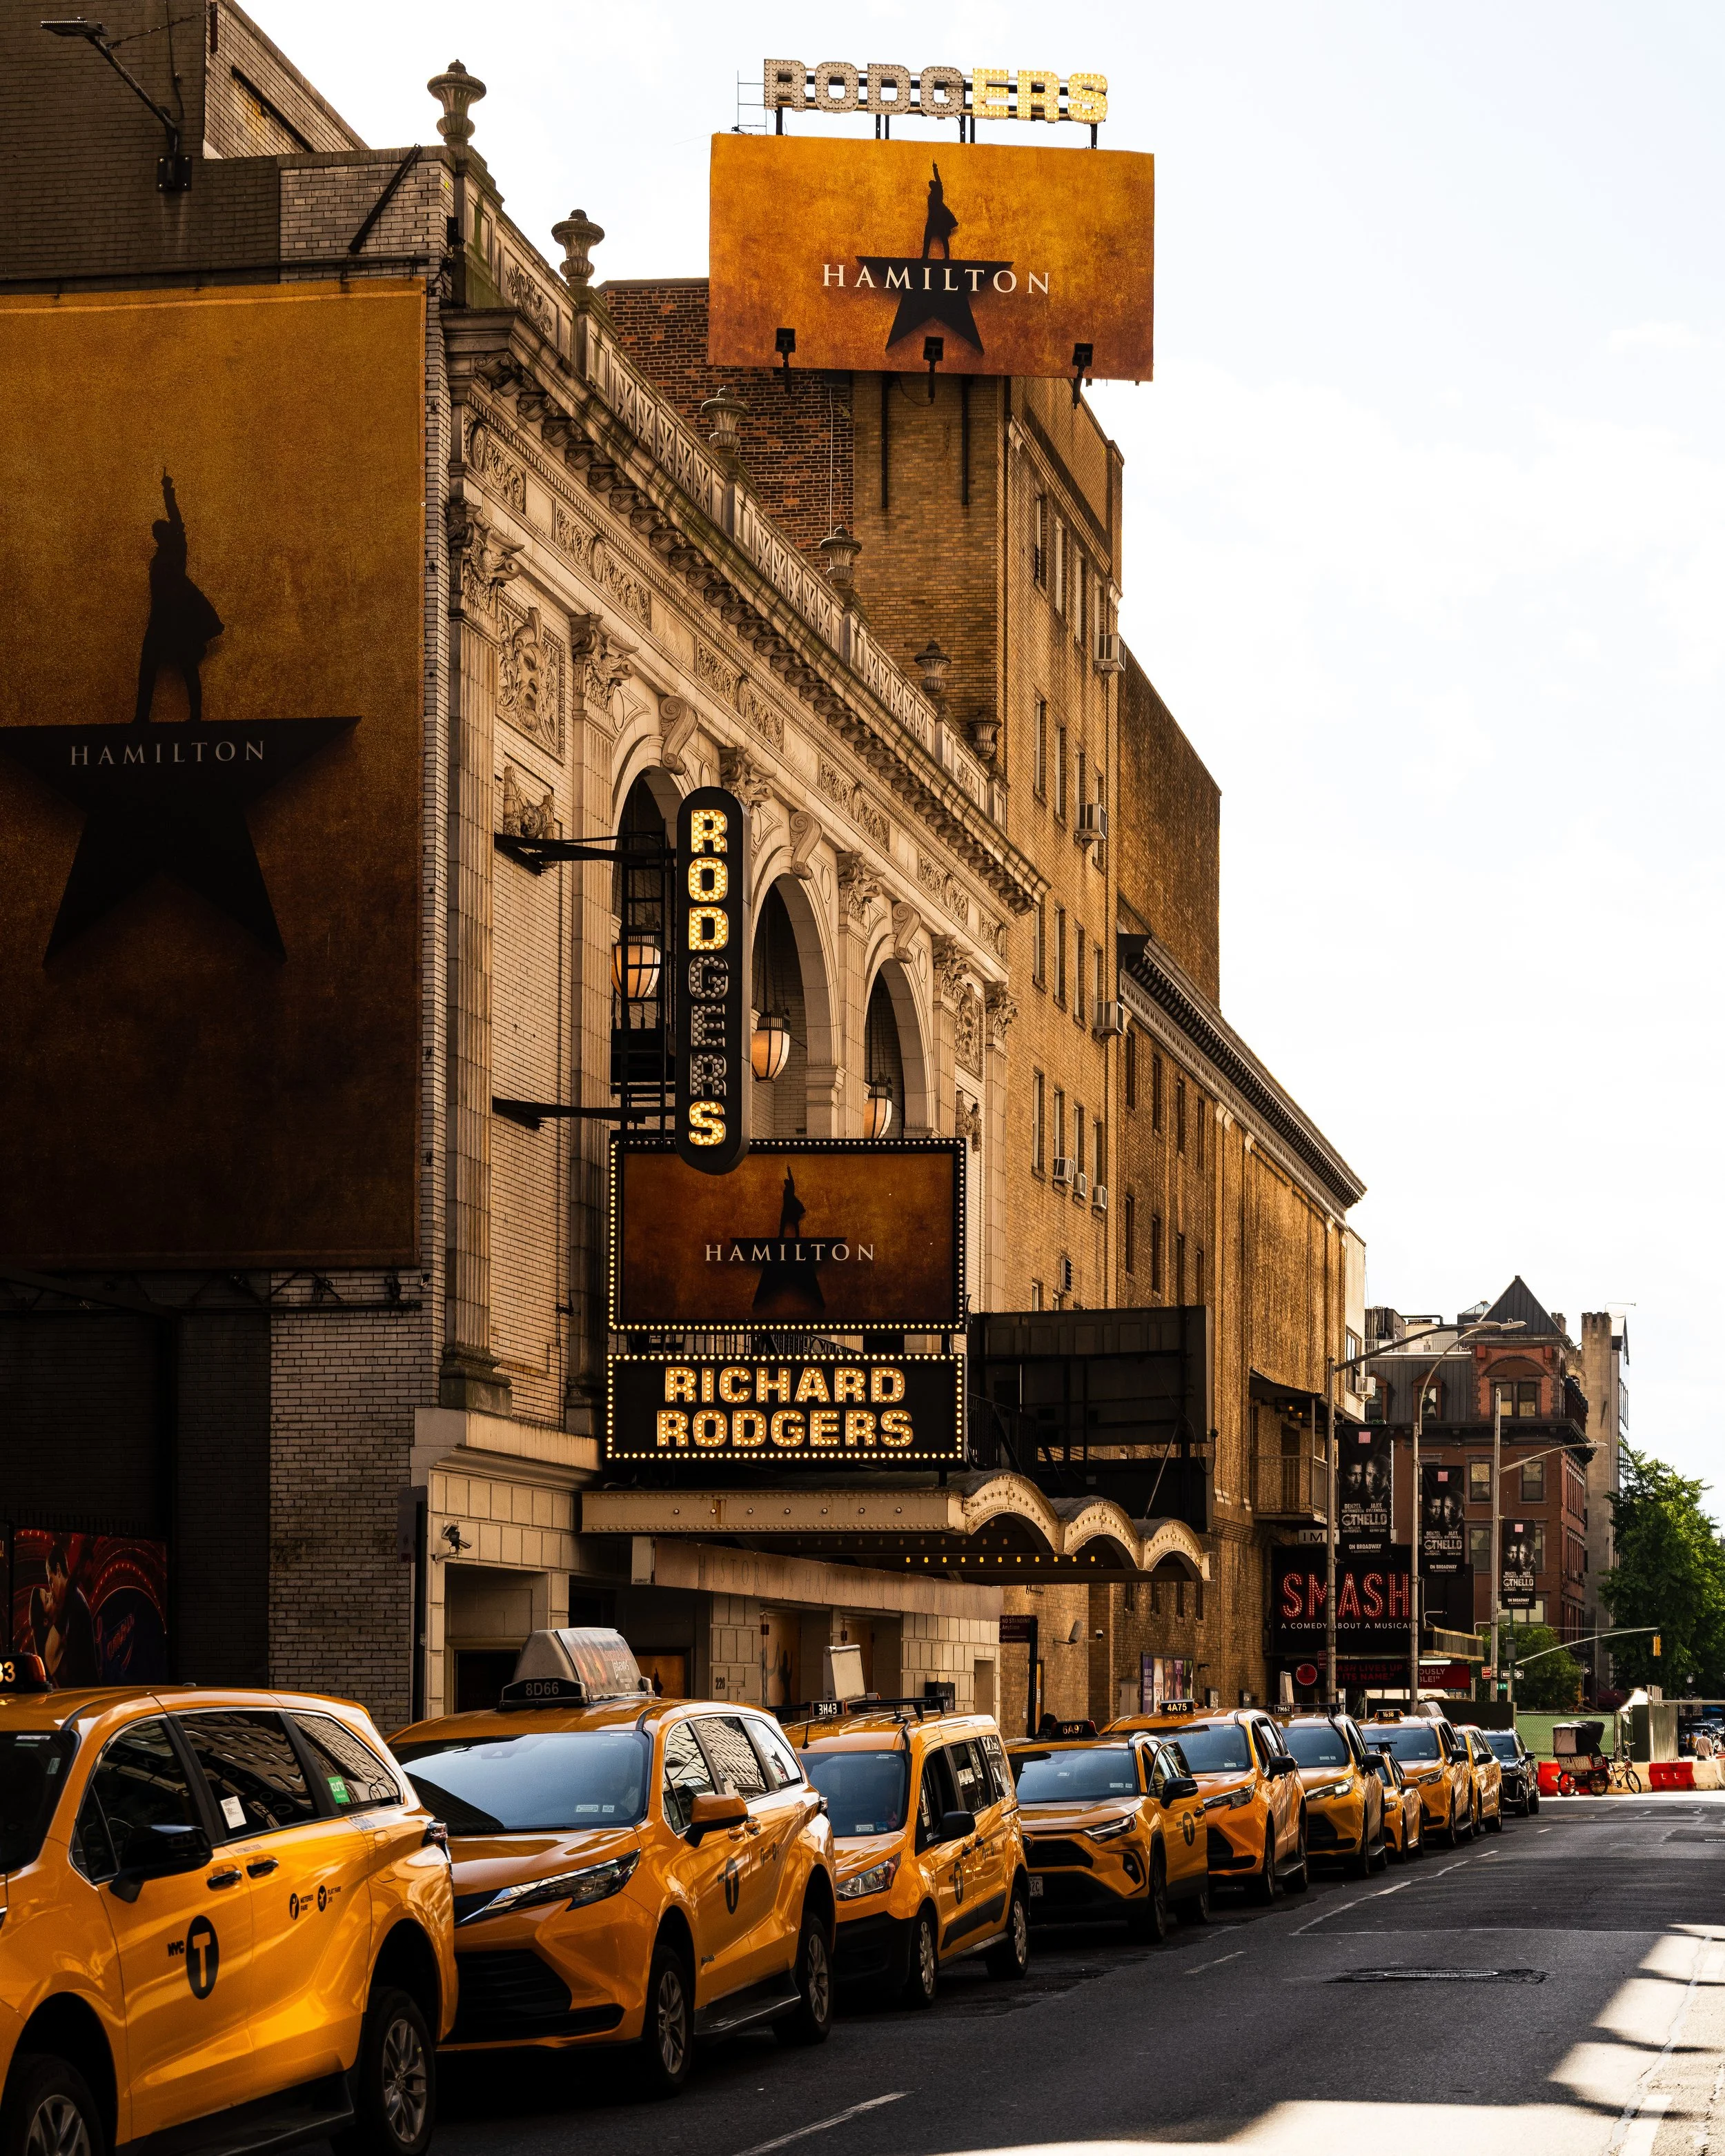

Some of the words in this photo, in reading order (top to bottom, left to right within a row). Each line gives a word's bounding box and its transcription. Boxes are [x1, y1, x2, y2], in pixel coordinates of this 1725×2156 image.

[764, 59, 1108, 124] RODGERS
[821, 264, 1050, 295] HAMILTON
[70, 740, 265, 766] HAMILTON
[688, 809, 729, 1146] RODGERS
[704, 1244, 874, 1261] HAMILTON
[664, 1367, 906, 1403] RICHARD
[657, 1410, 914, 1447] RODGERS
[1341, 1513, 1388, 1526] OTHELLO
[1424, 1539, 1462, 1550] OTHELLO
[698, 1554, 771, 1588] HISTORY
[782, 1566, 794, 1592] IS
[805, 1569, 884, 1601] HAPPENING
[1503, 1578, 1534, 1587] OTHELLO
[1283, 1573, 1409, 1617] SMASH
[525, 1681, 559, 1697] 8D66
[818, 1703, 837, 1715] 3H43
[1167, 1703, 1187, 1712] 4A75
[1063, 1724, 1084, 1734] 6A97
[331, 1780, 345, 1792] curb
[168, 1939, 185, 1957] NYC
